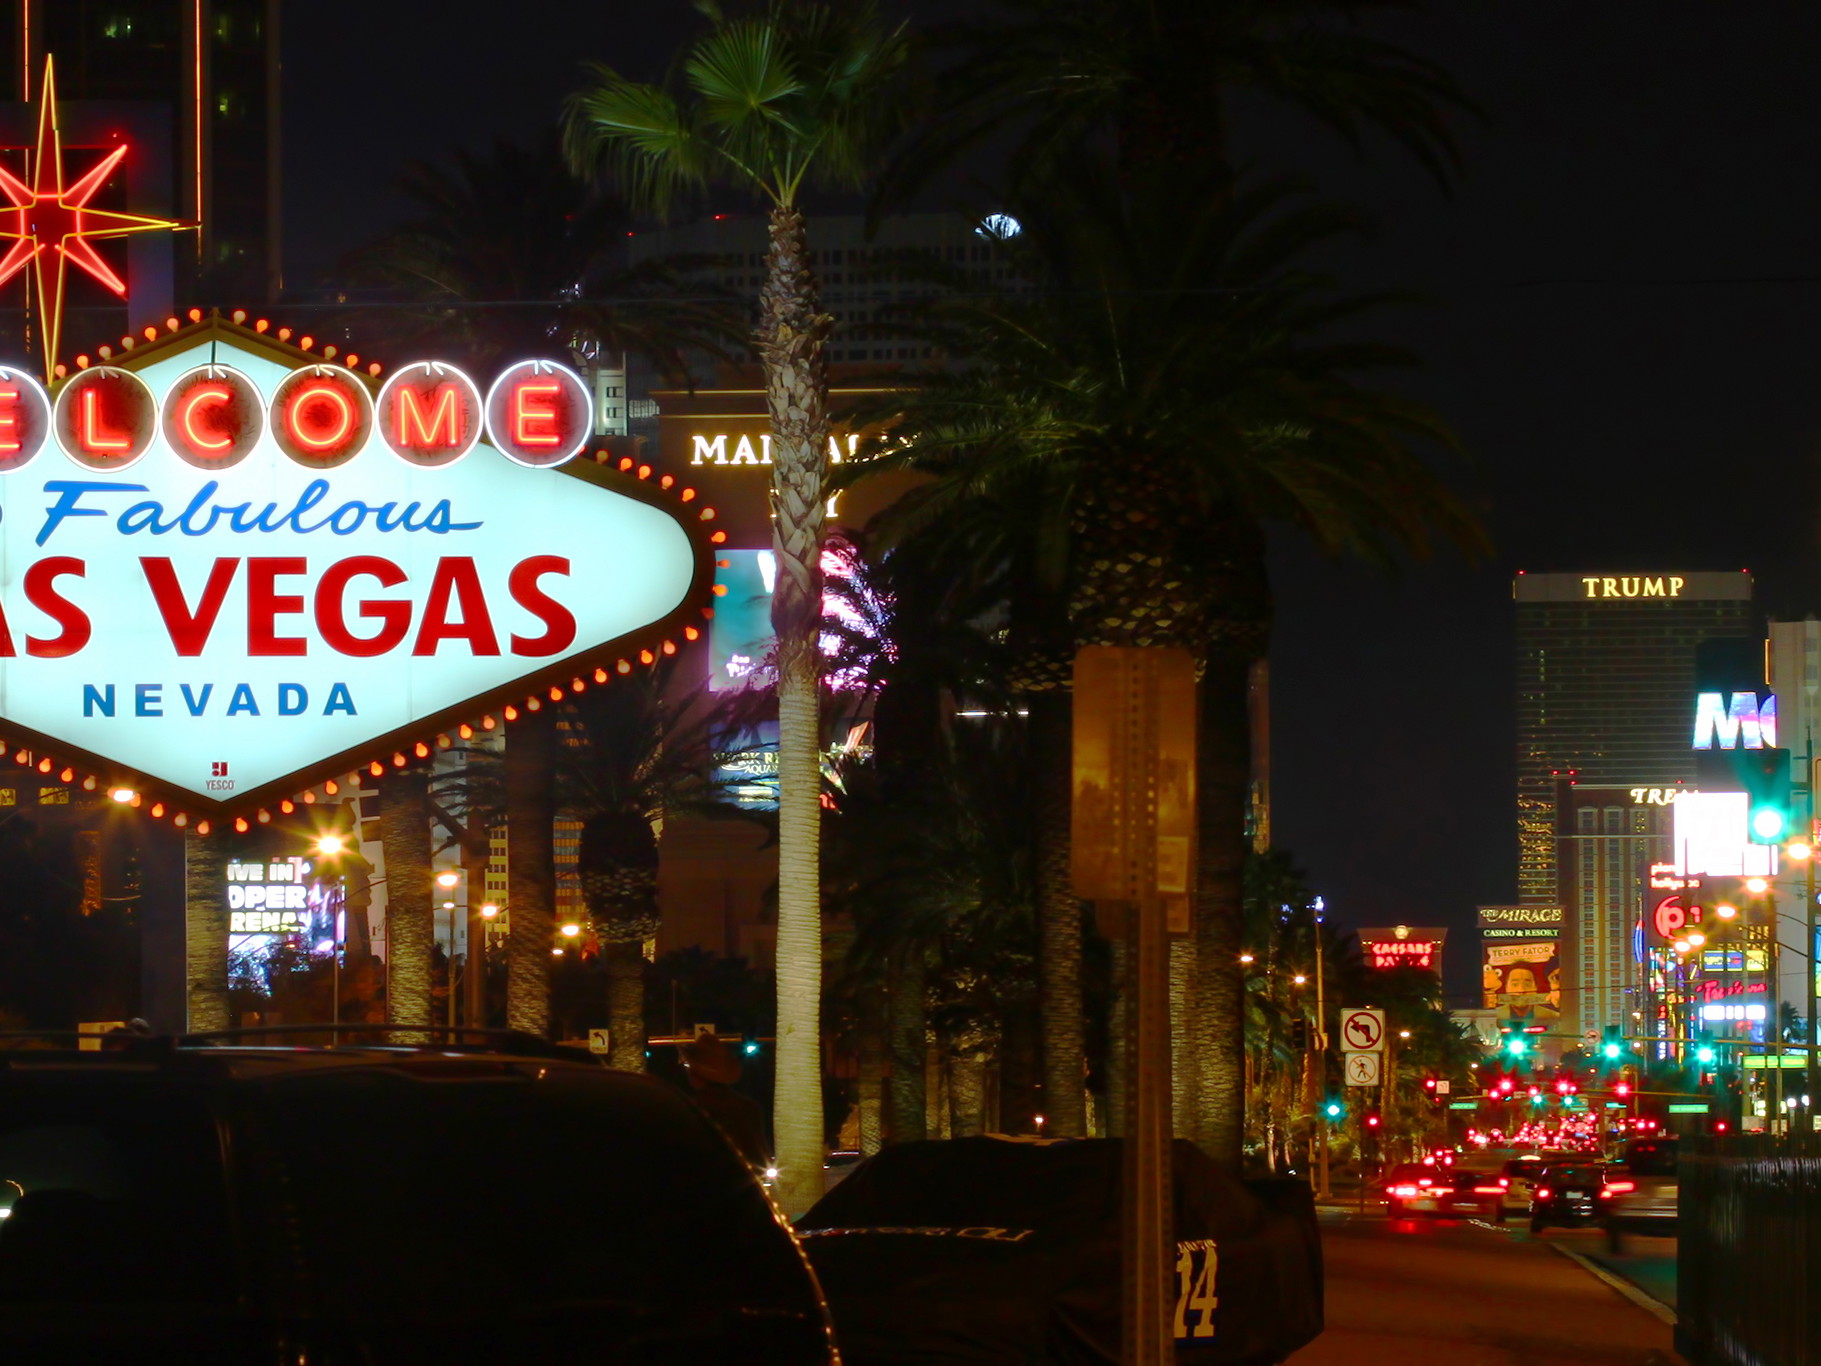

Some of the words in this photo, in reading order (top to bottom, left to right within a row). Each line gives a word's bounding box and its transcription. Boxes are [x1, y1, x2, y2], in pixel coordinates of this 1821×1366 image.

[35, 479, 484, 547] Fabulous
[1582, 577, 1685, 598] TRUMP
[0, 555, 92, 658] S
[139, 555, 577, 658] VEGAS
[83, 682, 358, 718] NEVADA
[205, 780, 235, 790] YESCO
[1491, 909, 1562, 922] MIRAGE
[1483, 929, 1516, 937] CASINO
[1525, 929, 1559, 937] RESORT
[1372, 943, 1432, 954] CAESARS
[1492, 948, 1520, 957] TERRY
[1522, 946, 1550, 955] FATOR
